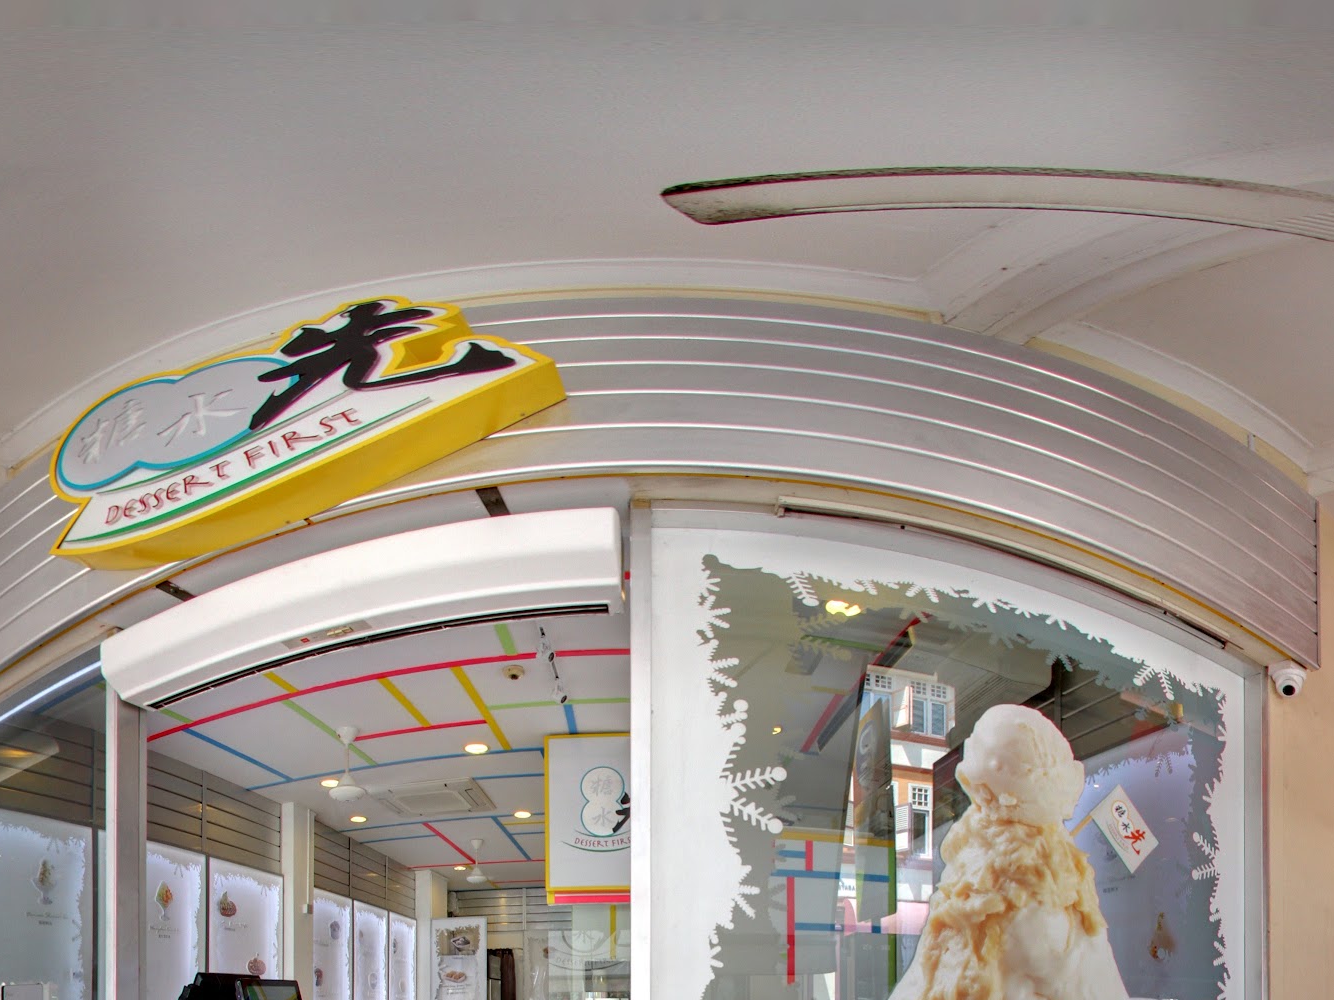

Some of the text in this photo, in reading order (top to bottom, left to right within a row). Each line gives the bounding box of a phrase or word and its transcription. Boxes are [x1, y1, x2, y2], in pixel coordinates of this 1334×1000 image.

[104, 408, 362, 526] DESSERT FIRST
[574, 837, 609, 848] DESSERT
